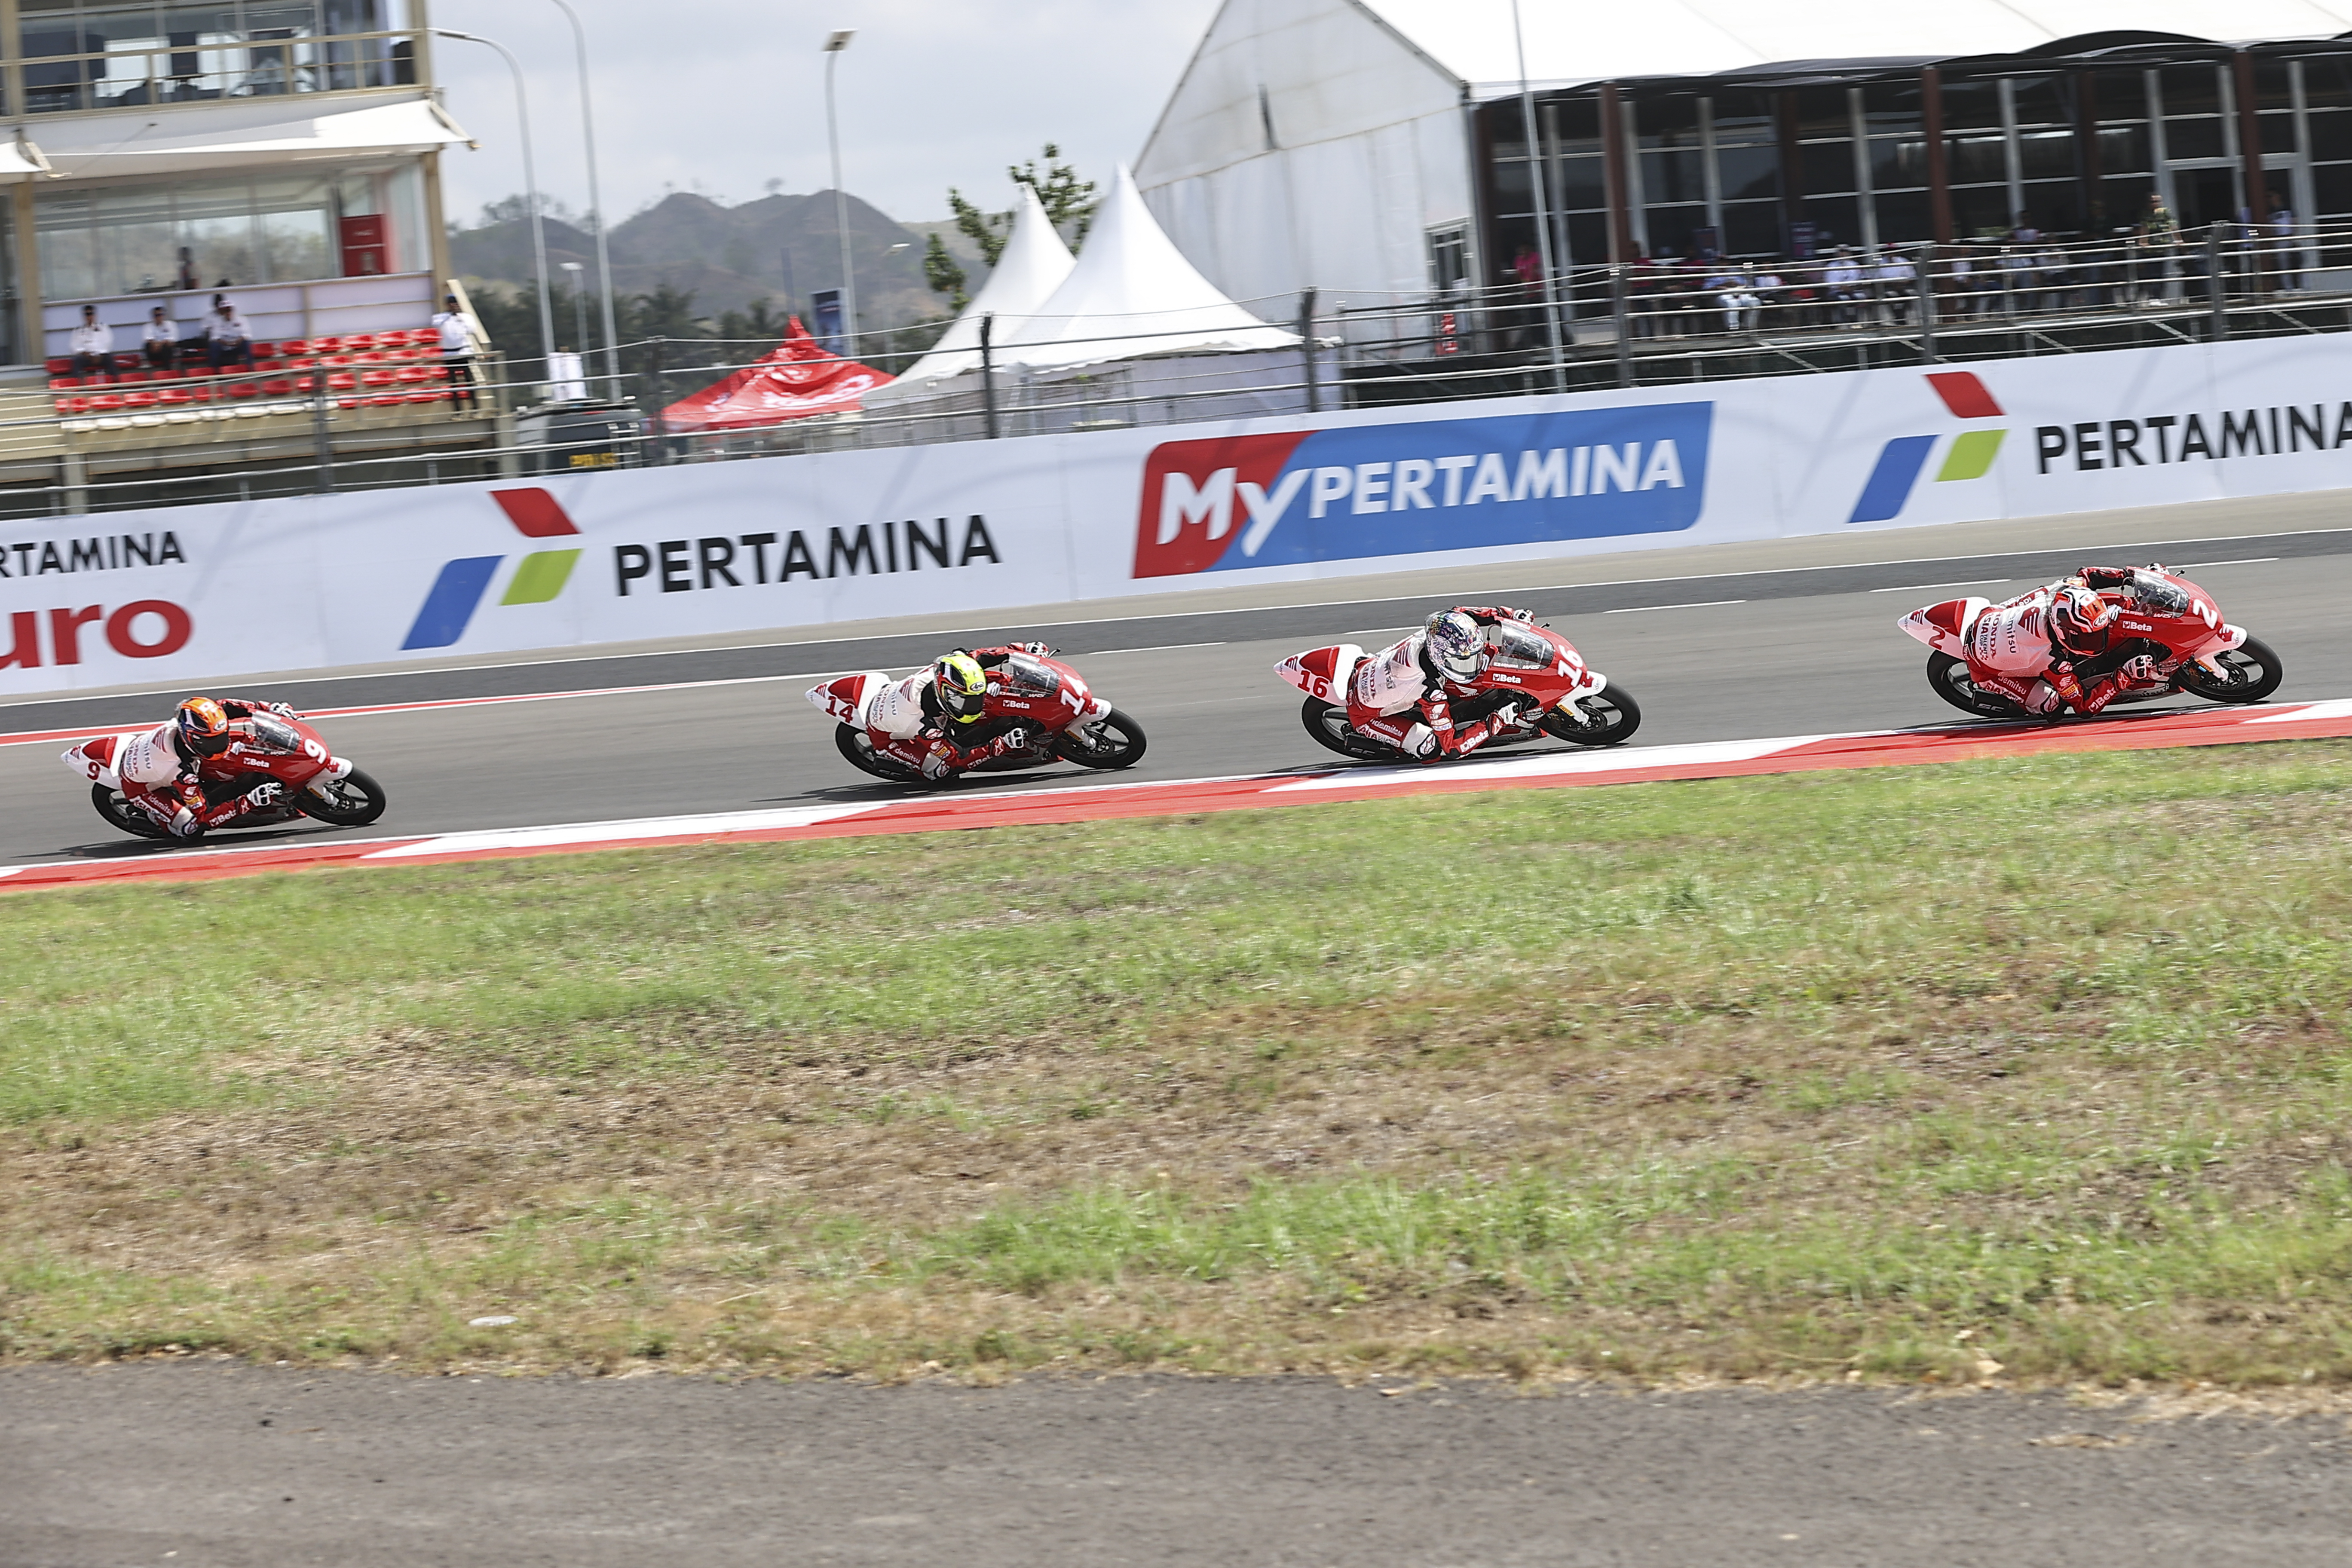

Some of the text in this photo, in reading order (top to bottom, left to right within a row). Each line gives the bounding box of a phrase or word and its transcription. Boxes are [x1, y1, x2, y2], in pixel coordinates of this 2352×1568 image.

[613, 514, 1002, 597] PERTAMINA
[2130, 621, 2152, 631] Beta
[2193, 599, 2218, 630] 2
[1928, 625, 1946, 650] 2
[1500, 674, 1521, 683] Beta
[1557, 645, 1584, 688] 16
[1060, 674, 1088, 716] 14
[1298, 670, 1329, 698] 16
[825, 696, 853, 723] 14
[1010, 701, 1030, 709] Beta
[304, 739, 327, 764] 9
[87, 761, 100, 781] 9
[148, 794, 175, 816] idemitsu
